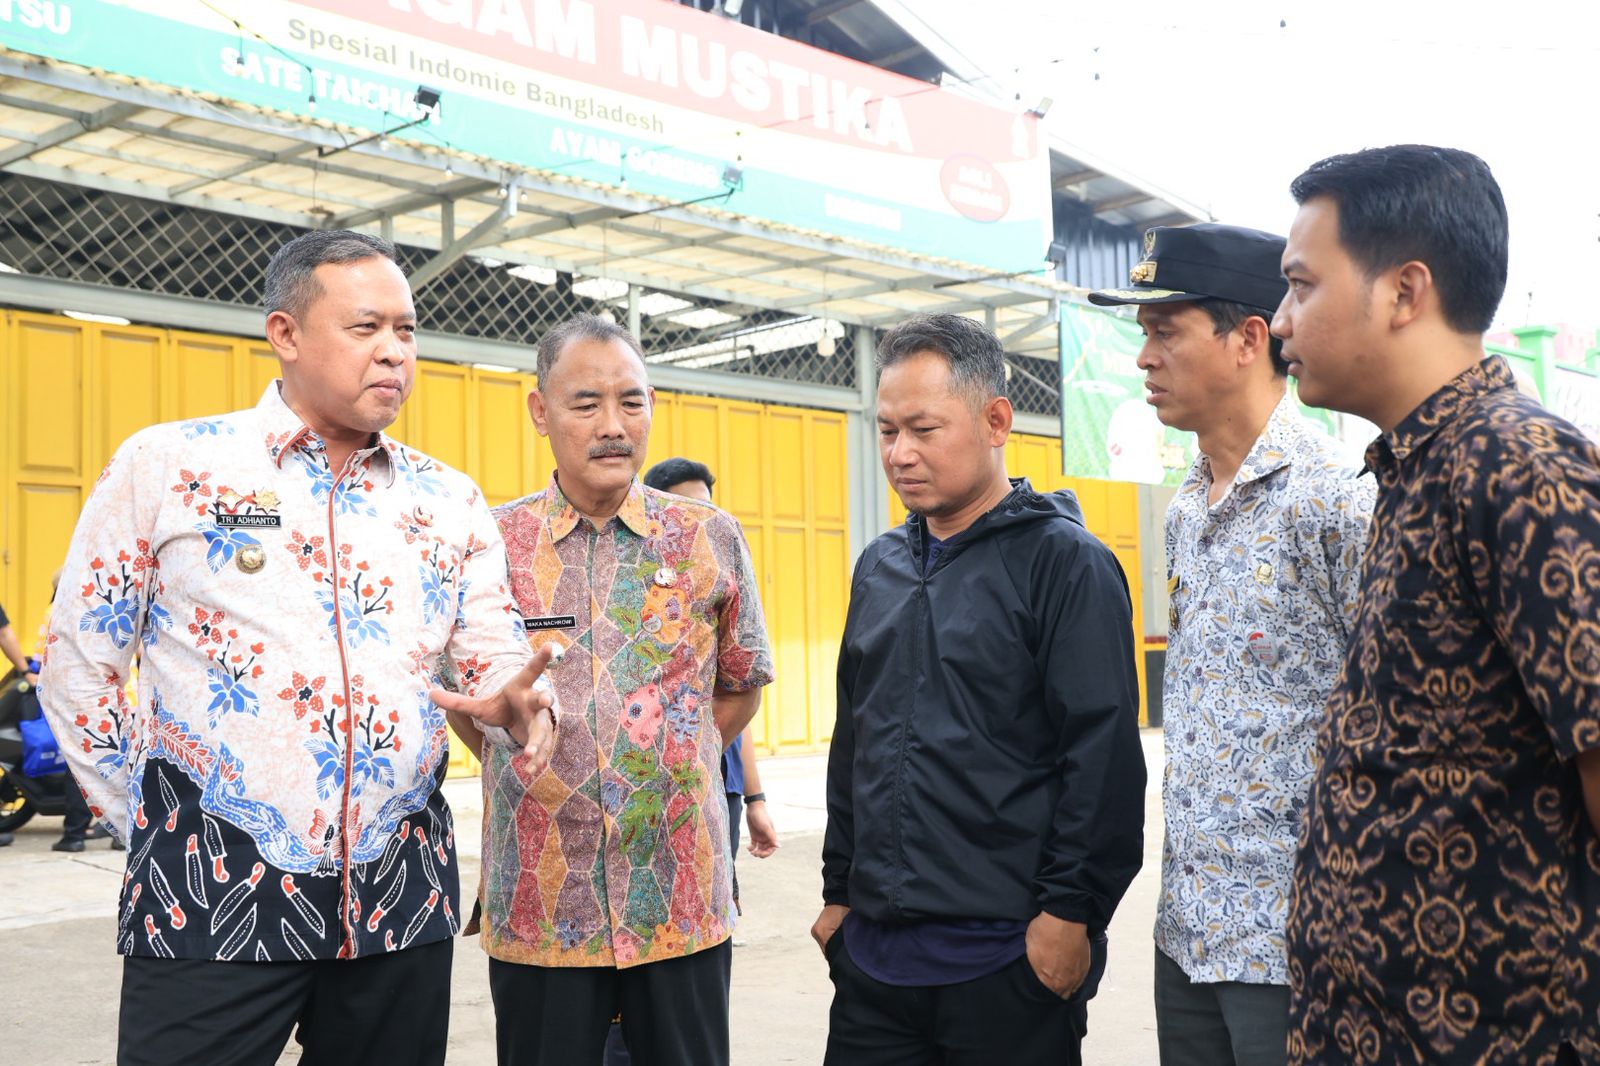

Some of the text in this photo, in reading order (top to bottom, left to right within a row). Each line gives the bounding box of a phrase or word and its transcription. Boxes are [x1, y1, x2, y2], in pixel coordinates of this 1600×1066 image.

[220, 47, 303, 92] SATE
[288, 18, 664, 135] Spesial Indomie Bangladesh
[620, 15, 913, 154] MUSTIKA
[550, 127, 621, 168] AYAM
[221, 516, 277, 525] TRI ADHIANTO
